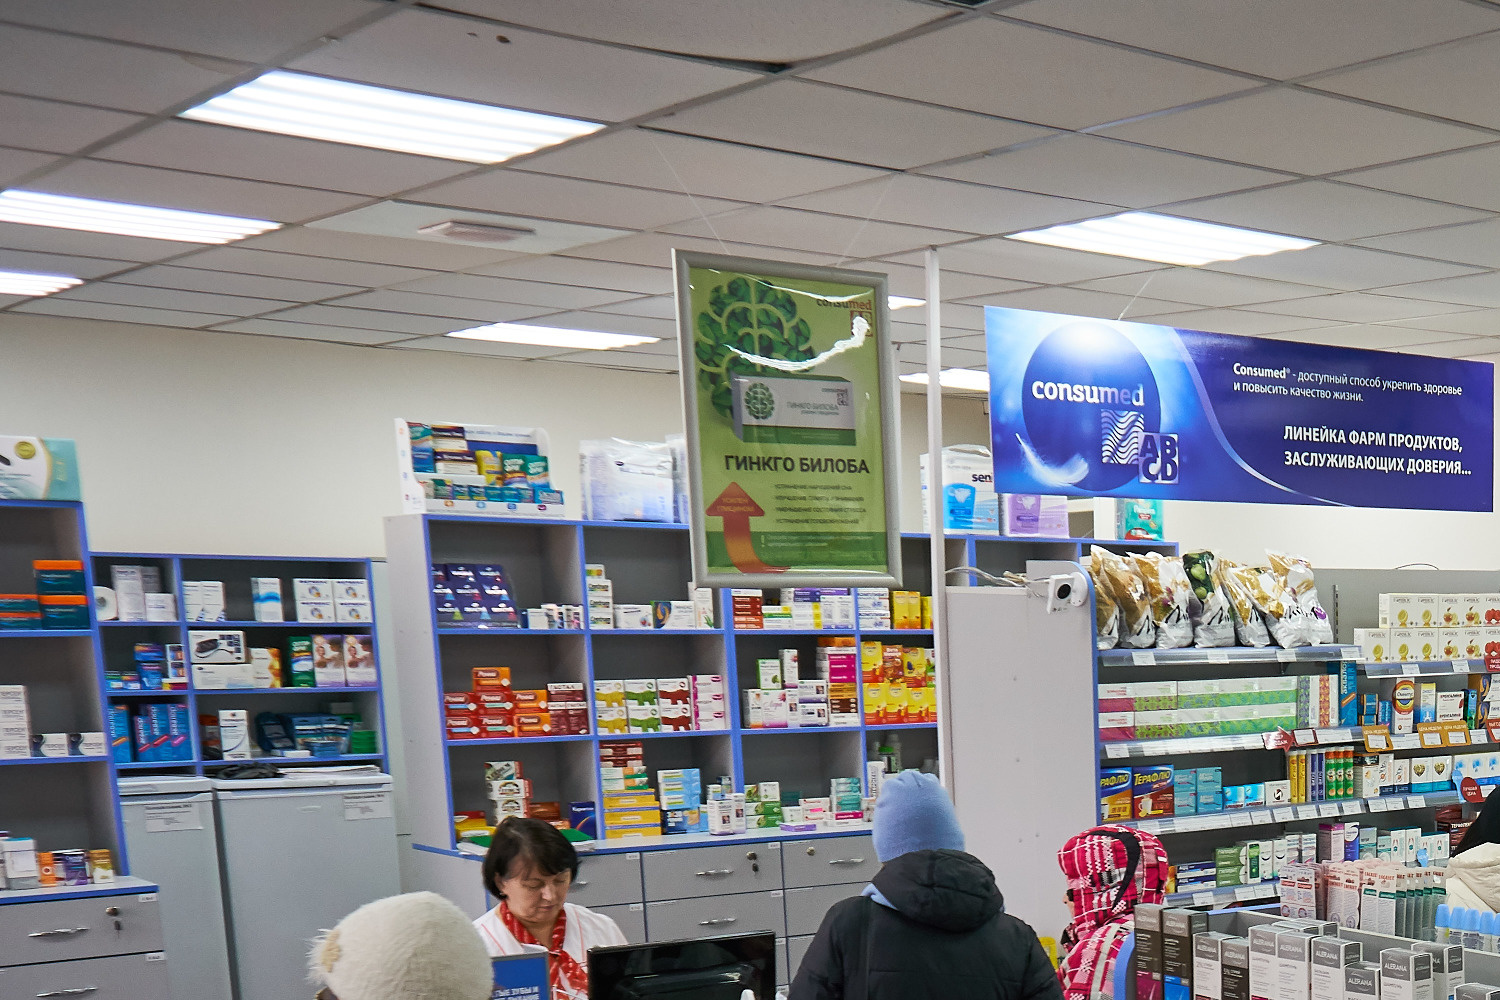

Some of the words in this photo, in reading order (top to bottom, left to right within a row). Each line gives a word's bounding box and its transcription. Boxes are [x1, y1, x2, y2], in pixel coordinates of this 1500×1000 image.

[1032, 380, 1144, 406] consumed
[1233, 381, 1240, 391] и
[1242, 383, 1288, 395] повысить
[1290, 387, 1331, 399] качество
[1333, 390, 1364, 402] жизни.
[1298, 371, 1348, 385] доступный
[1349, 376, 1381, 388] способ
[1382, 379, 1421, 392] укрепить
[1423, 382, 1462, 396] здоровье
[1284, 425, 1346, 443] ЛИНЕЙКА
[1349, 430, 1386, 447] ФАРМ
[1389, 433, 1463, 452] ПРОДУКТОВ,
[724, 455, 795, 472] ГИНКГО
[799, 458, 870, 474] БИЛОБА
[1284, 451, 1405, 472] ЗАСЛУЖИВАЮЩИХ
[1407, 458, 1471, 475] ДОВЕРИЯ...
[1134, 770, 1172, 785] ТЕРАФЛЮ
[1384, 963, 1408, 973] ALERANA
